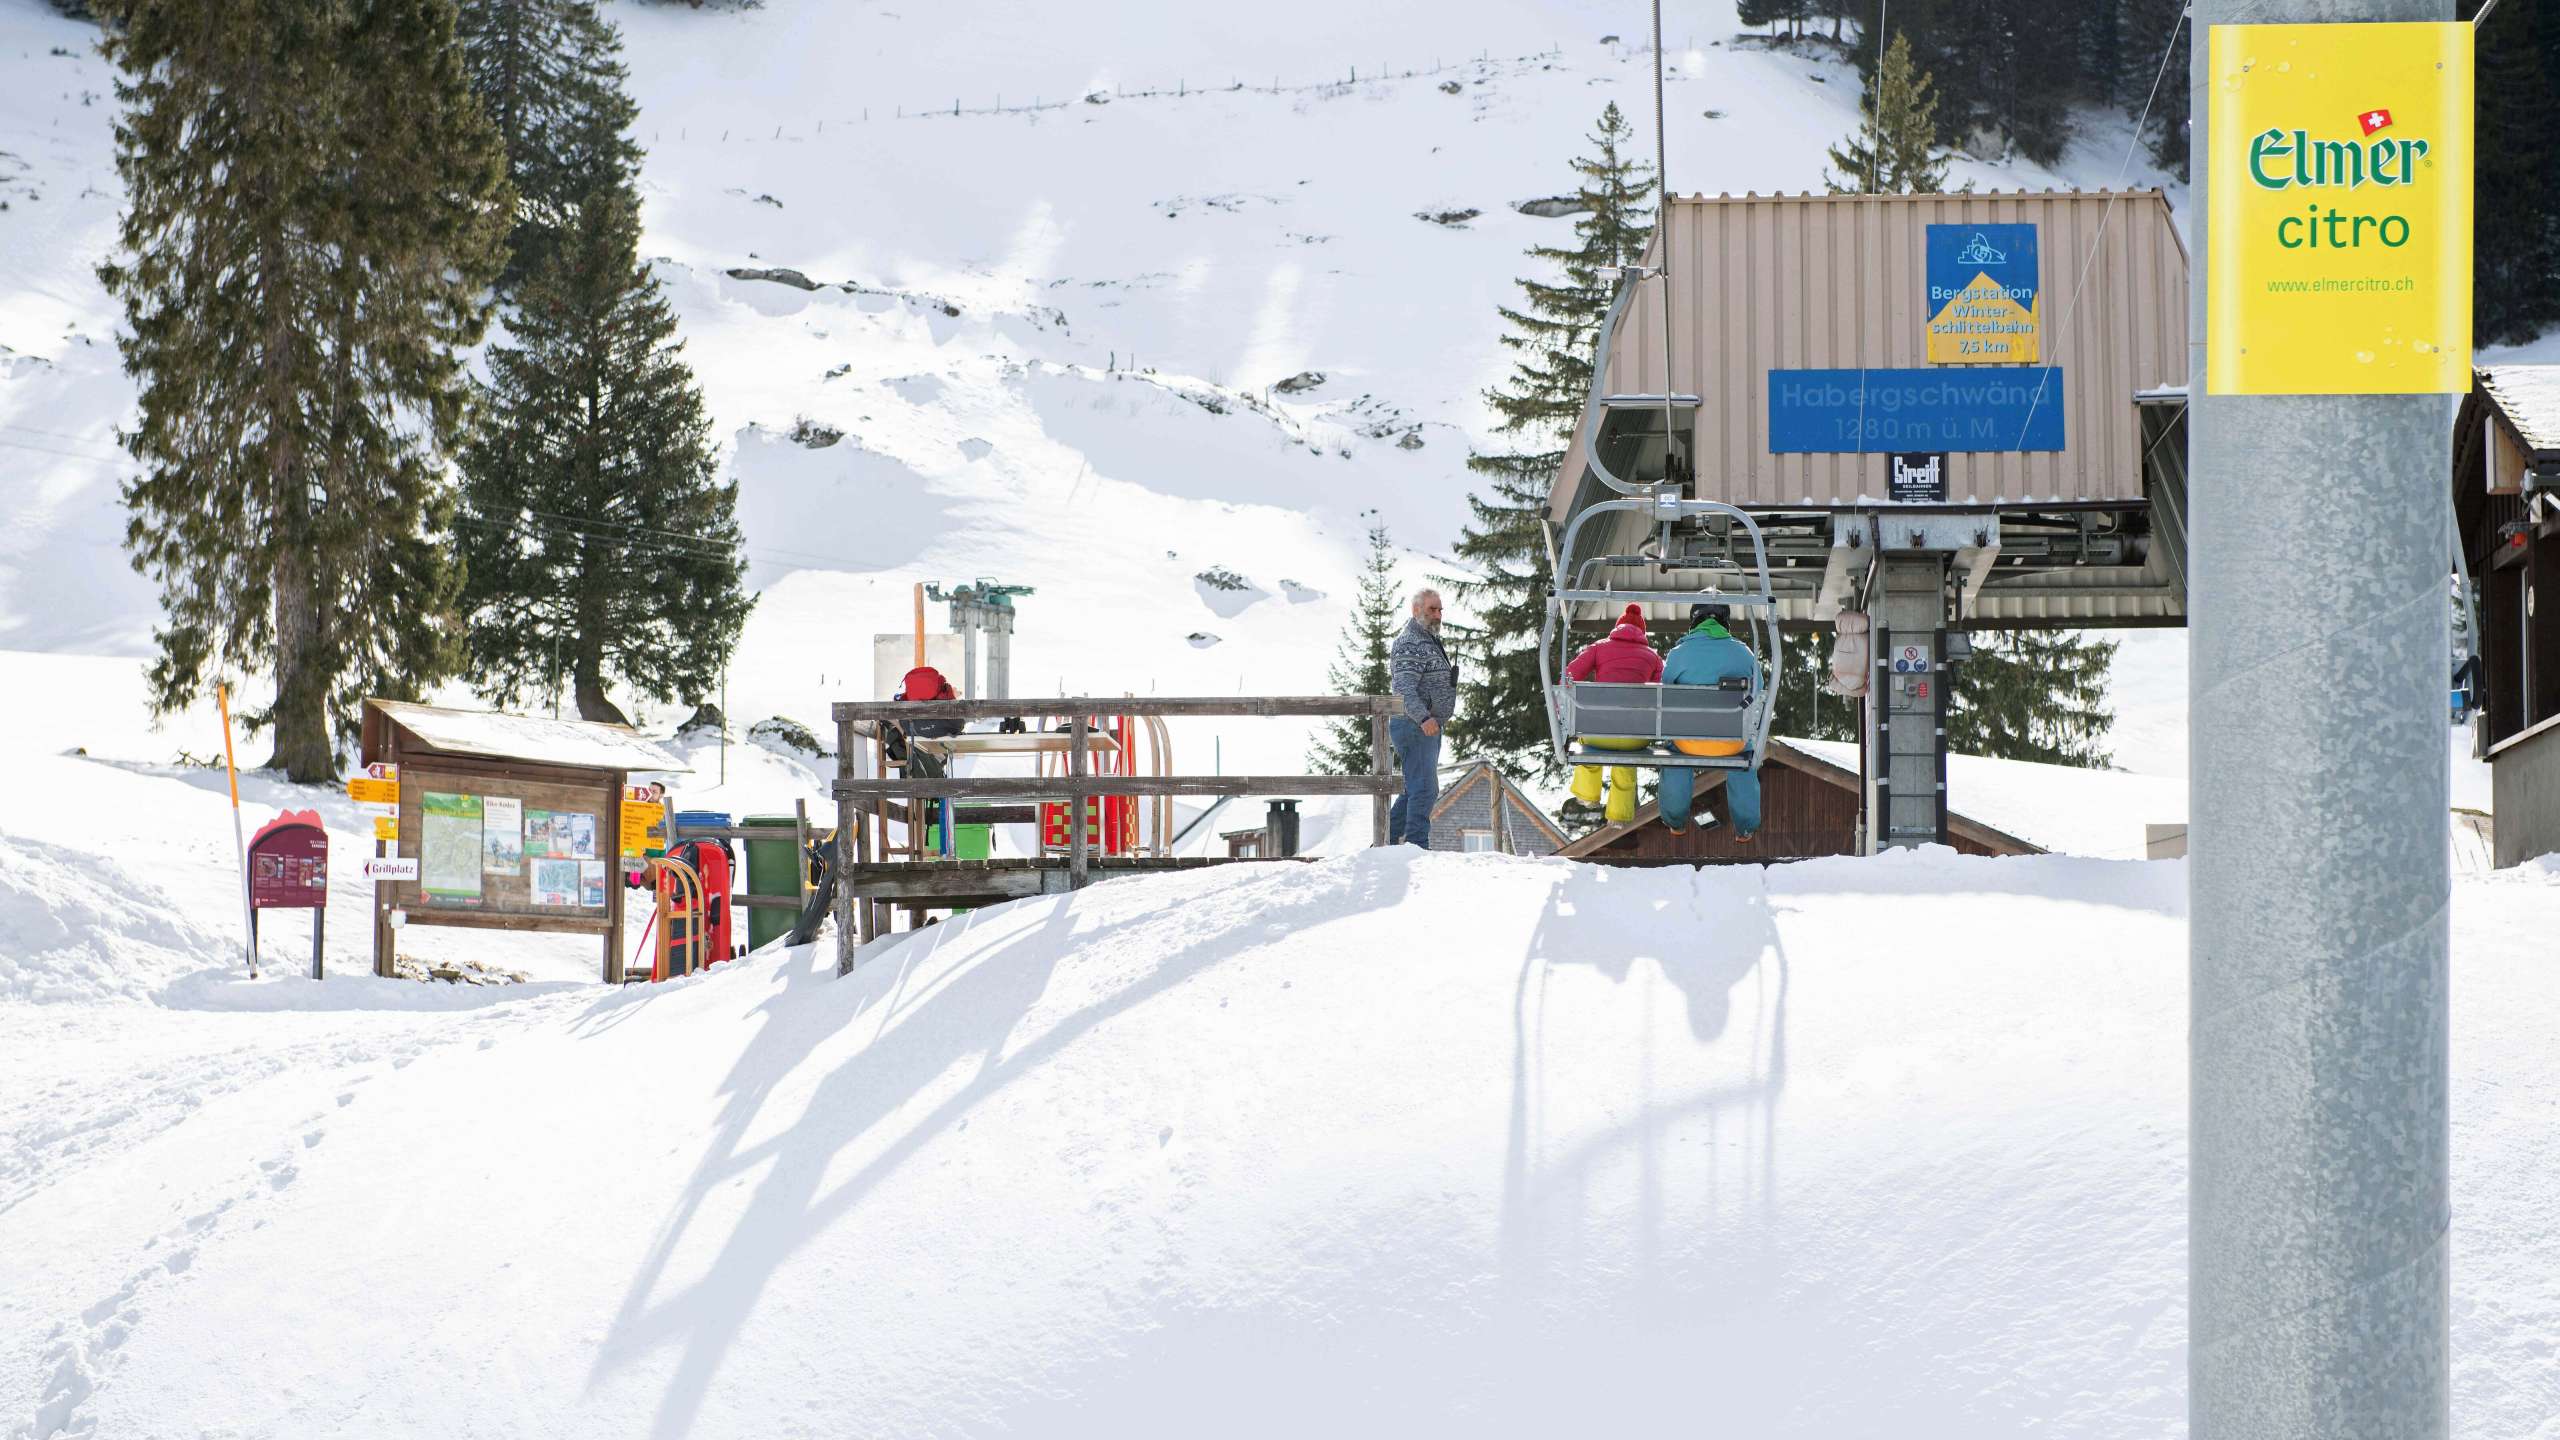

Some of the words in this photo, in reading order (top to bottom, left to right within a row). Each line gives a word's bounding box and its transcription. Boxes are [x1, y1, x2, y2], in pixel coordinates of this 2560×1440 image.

[2249, 127, 2428, 190] Elmer
[2277, 204, 2410, 248] citro
[2266, 275, 2414, 293] www.elmercitro.ch
[1931, 285, 2033, 303] Bergstation
[1951, 304, 2016, 318] Winter-
[1933, 321, 2034, 334] schlittelbahn
[1959, 340, 1980, 355] 7,5
[1984, 339, 2009, 353] km
[1781, 381, 2051, 412] Habergschwänd
[1835, 418, 1899, 440] 1280
[1906, 423, 1931, 439] m
[372, 863, 414, 876] Grillplatz
